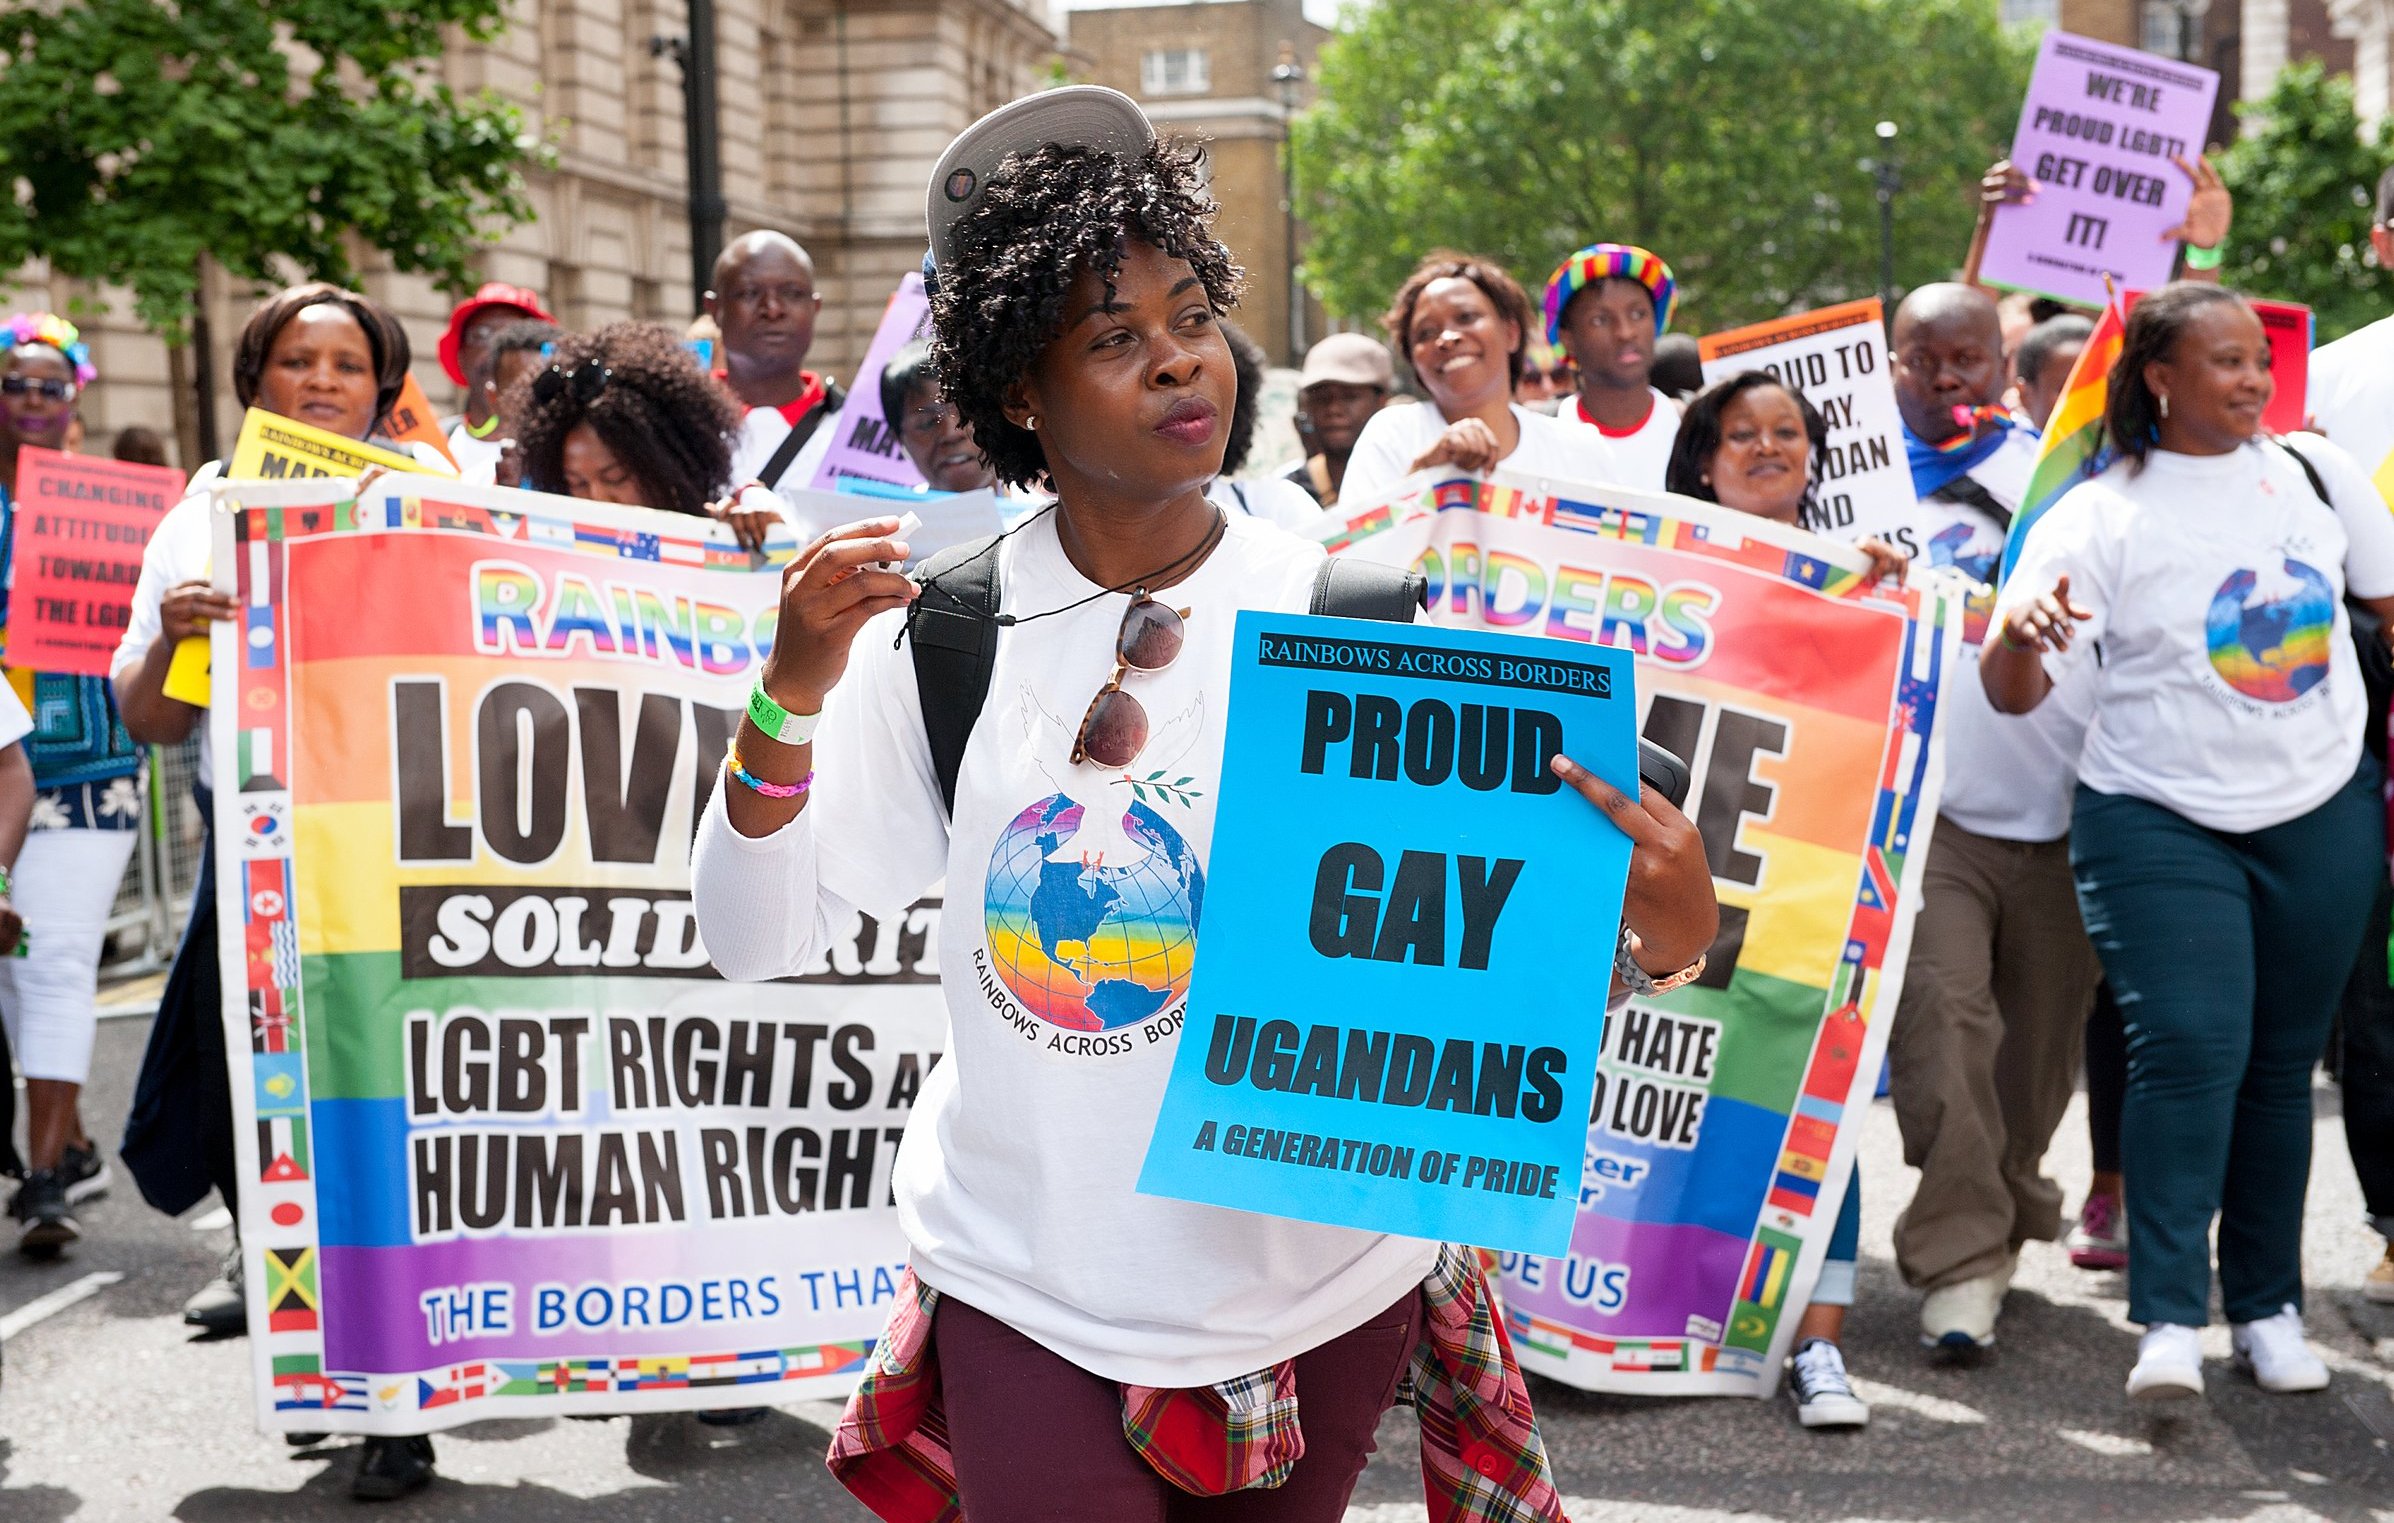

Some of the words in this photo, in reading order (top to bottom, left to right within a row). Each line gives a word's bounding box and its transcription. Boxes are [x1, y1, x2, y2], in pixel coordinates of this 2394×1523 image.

[2085, 71, 2162, 113] WE'RE
[2033, 106, 2115, 146] PROUD
[2035, 152, 2090, 190] GET
[2093, 165, 2167, 208] OVER
[2065, 211, 2110, 251] IT!
[1835, 341, 1874, 379] TO
[1822, 393, 1862, 430] AY,
[1825, 435, 1890, 481] DAN
[38, 475, 165, 511] CHANGING
[34, 598, 78, 624] THE
[86, 602, 131, 628] LGB
[479, 568, 778, 675] RAINB
[1414, 542, 1714, 664] ORDERS
[1260, 637, 1391, 671] RAINBOWS
[1397, 649, 1492, 681] ACROSS
[1498, 659, 1611, 694] BORDERS
[1300, 689, 1563, 797] PROUD
[1308, 841, 1526, 971] GAY
[972, 948, 1041, 1042] RAINBOWS
[1047, 1032, 1133, 1056] ACROSS
[410, 1016, 589, 1117] LGBT
[609, 1016, 876, 1112] RIGHTS
[1205, 1013, 1566, 1124] UGANDANS
[1617, 1009, 1716, 1078] HATE
[1611, 1078, 1703, 1143] LOVE
[414, 1129, 685, 1236] HUMAN
[1193, 1121, 1216, 1152] A
[1221, 1123, 1414, 1180] GENERATION
[1418, 1149, 1459, 1185] OF
[1464, 1155, 1561, 1200] PRIDE
[427, 1290, 508, 1338] THE
[538, 1276, 780, 1329] BORDERS
[800, 1263, 905, 1312] THA
[1566, 1258, 1625, 1308] US
